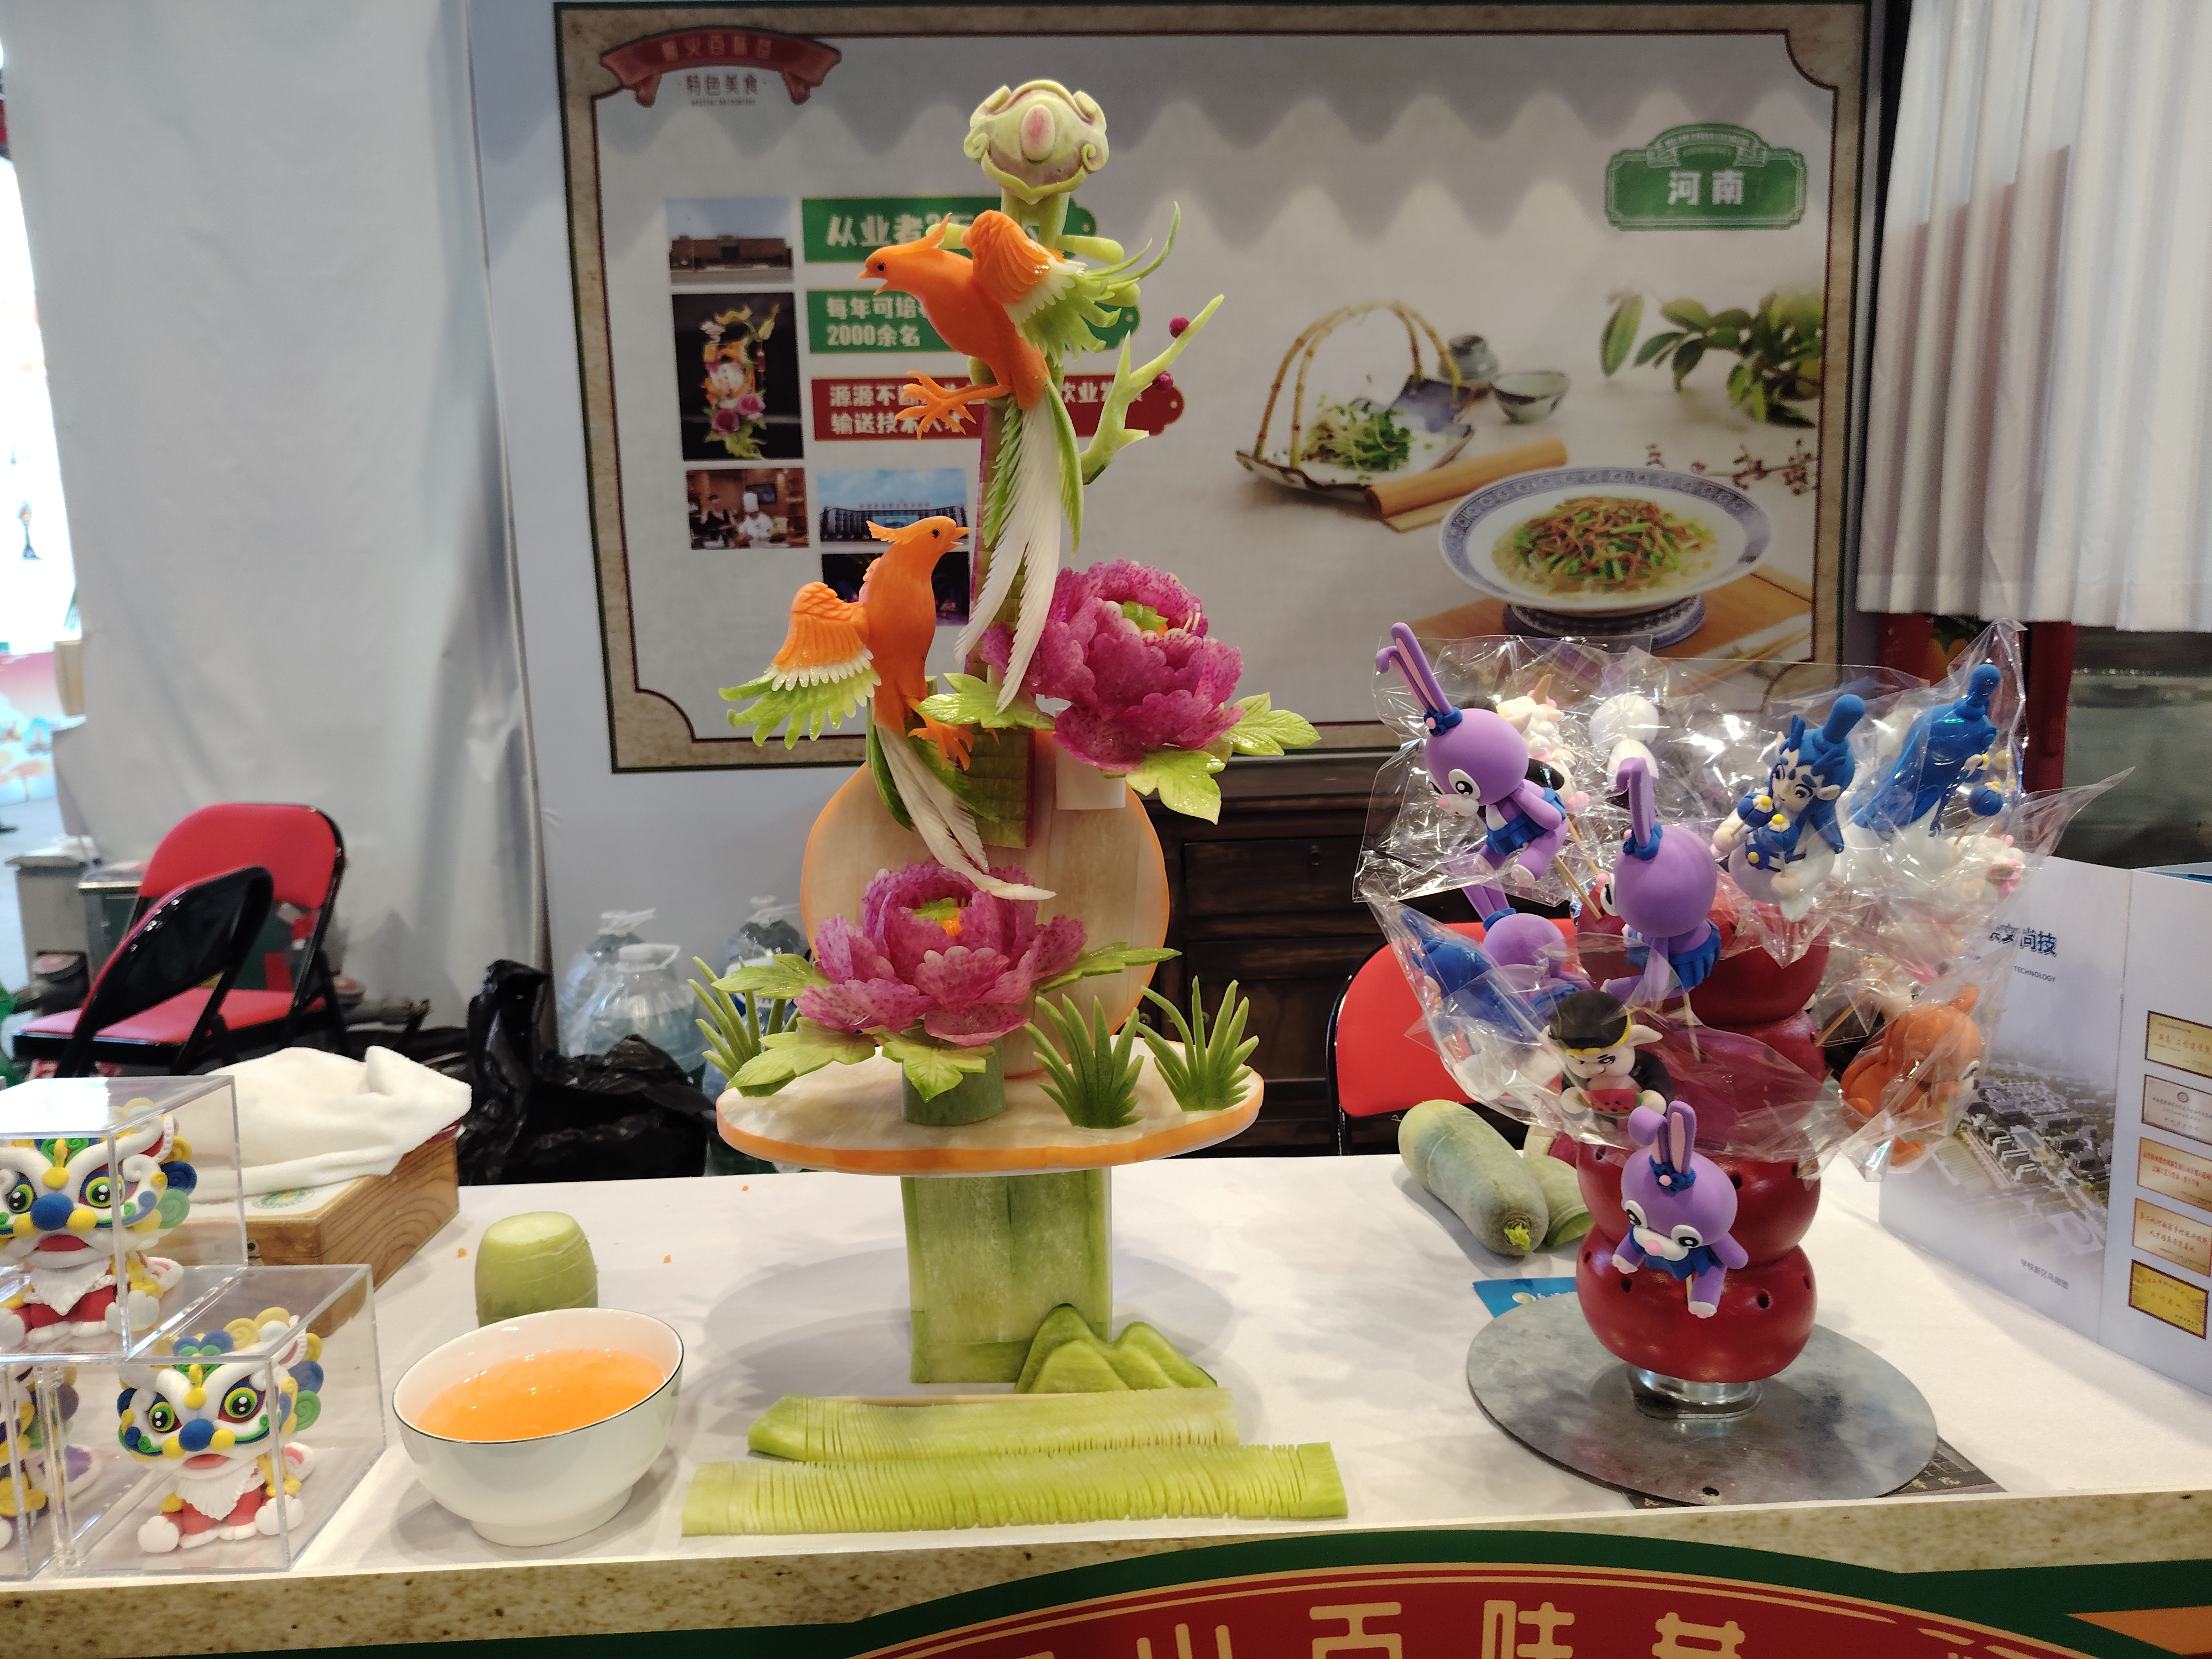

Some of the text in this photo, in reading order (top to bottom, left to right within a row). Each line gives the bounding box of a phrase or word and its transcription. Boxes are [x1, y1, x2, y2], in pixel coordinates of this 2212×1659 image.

[1667, 169, 1745, 206] 河南
[827, 296, 927, 320] 每年可培
[827, 324, 920, 347] 2000余名
[2013, 966, 2056, 982] TECHNOLOGY
